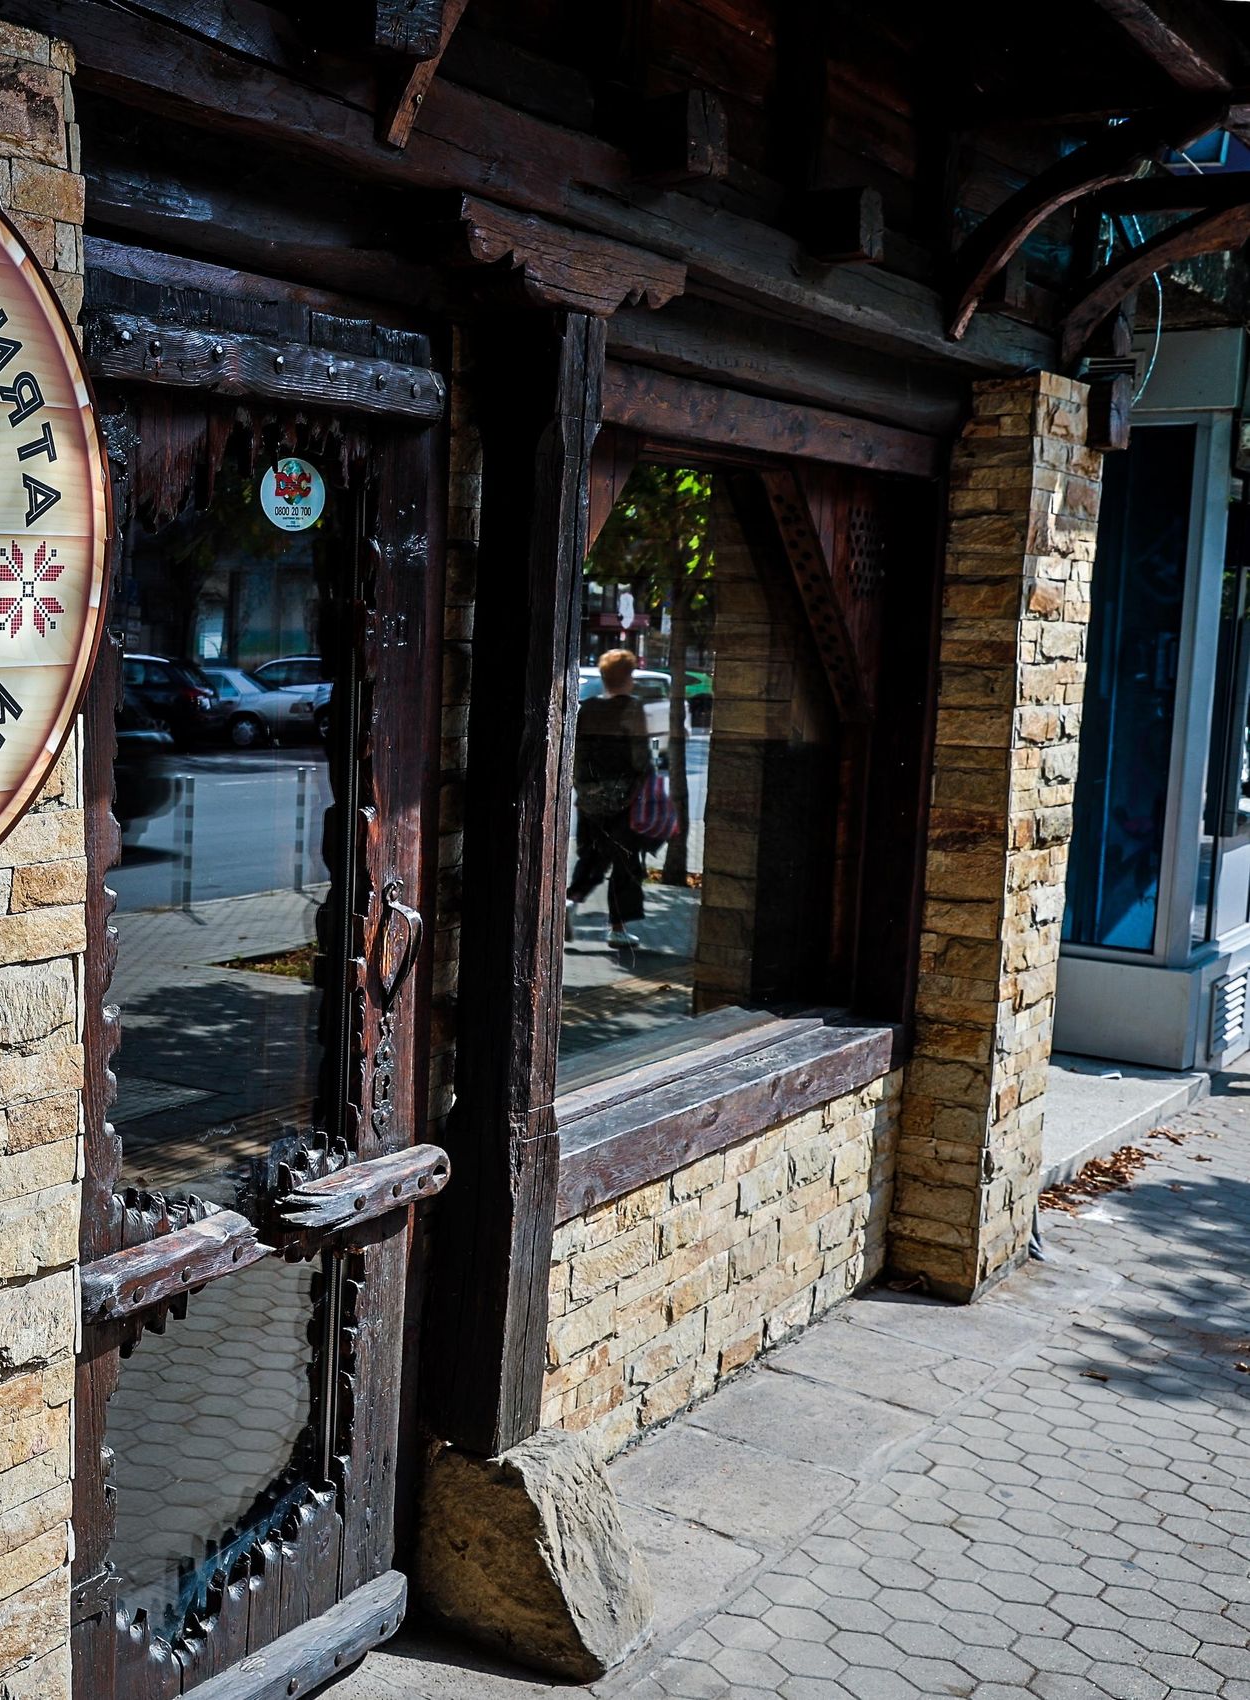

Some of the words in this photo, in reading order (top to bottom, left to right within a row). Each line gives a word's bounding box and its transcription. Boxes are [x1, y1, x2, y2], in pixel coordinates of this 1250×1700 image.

[275, 506, 289, 516] 0800
[291, 506, 299, 516] 20
[301, 506, 312, 516] 700
